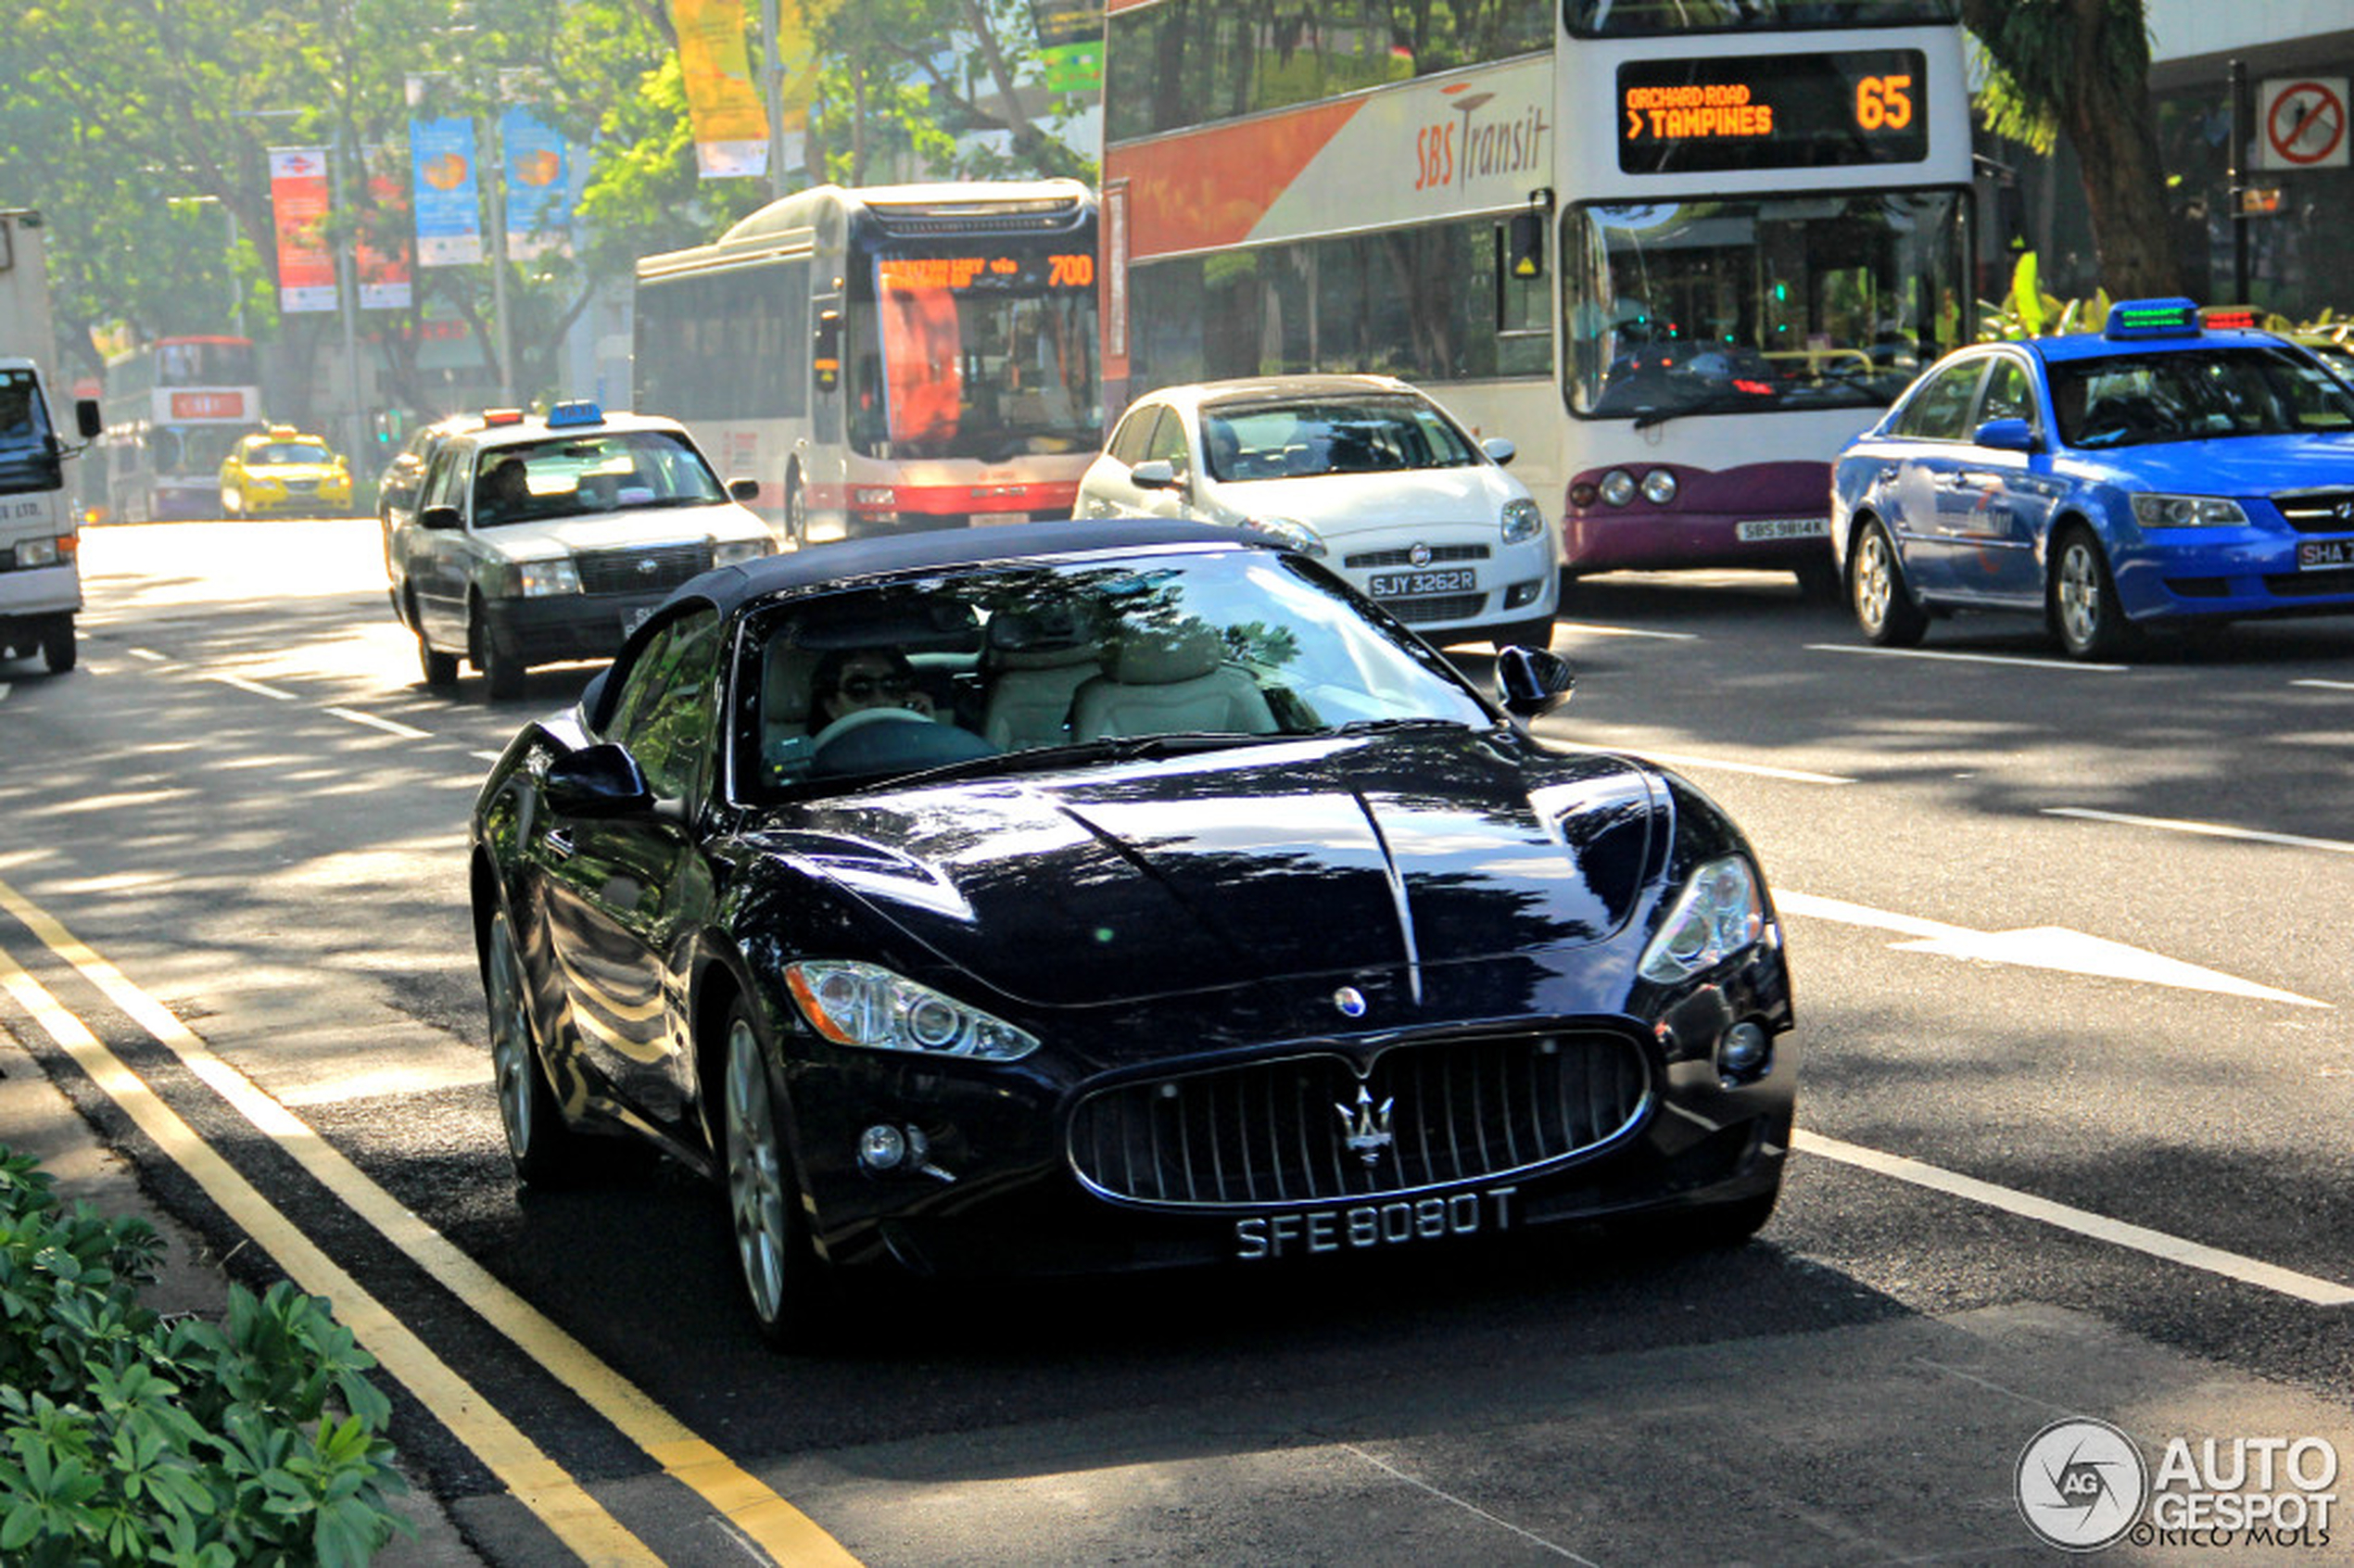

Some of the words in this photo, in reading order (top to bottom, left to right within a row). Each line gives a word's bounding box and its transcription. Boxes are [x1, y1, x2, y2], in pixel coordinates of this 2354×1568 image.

[1626, 86, 1703, 108] ORCHARD
[1704, 83, 1751, 106] ROAD
[1856, 74, 1912, 130] 65
[1649, 105, 1773, 139] TAMPINES
[1415, 120, 1454, 192] SBS
[1450, 93, 1551, 194] Transit
[1047, 254, 1094, 286] 700
